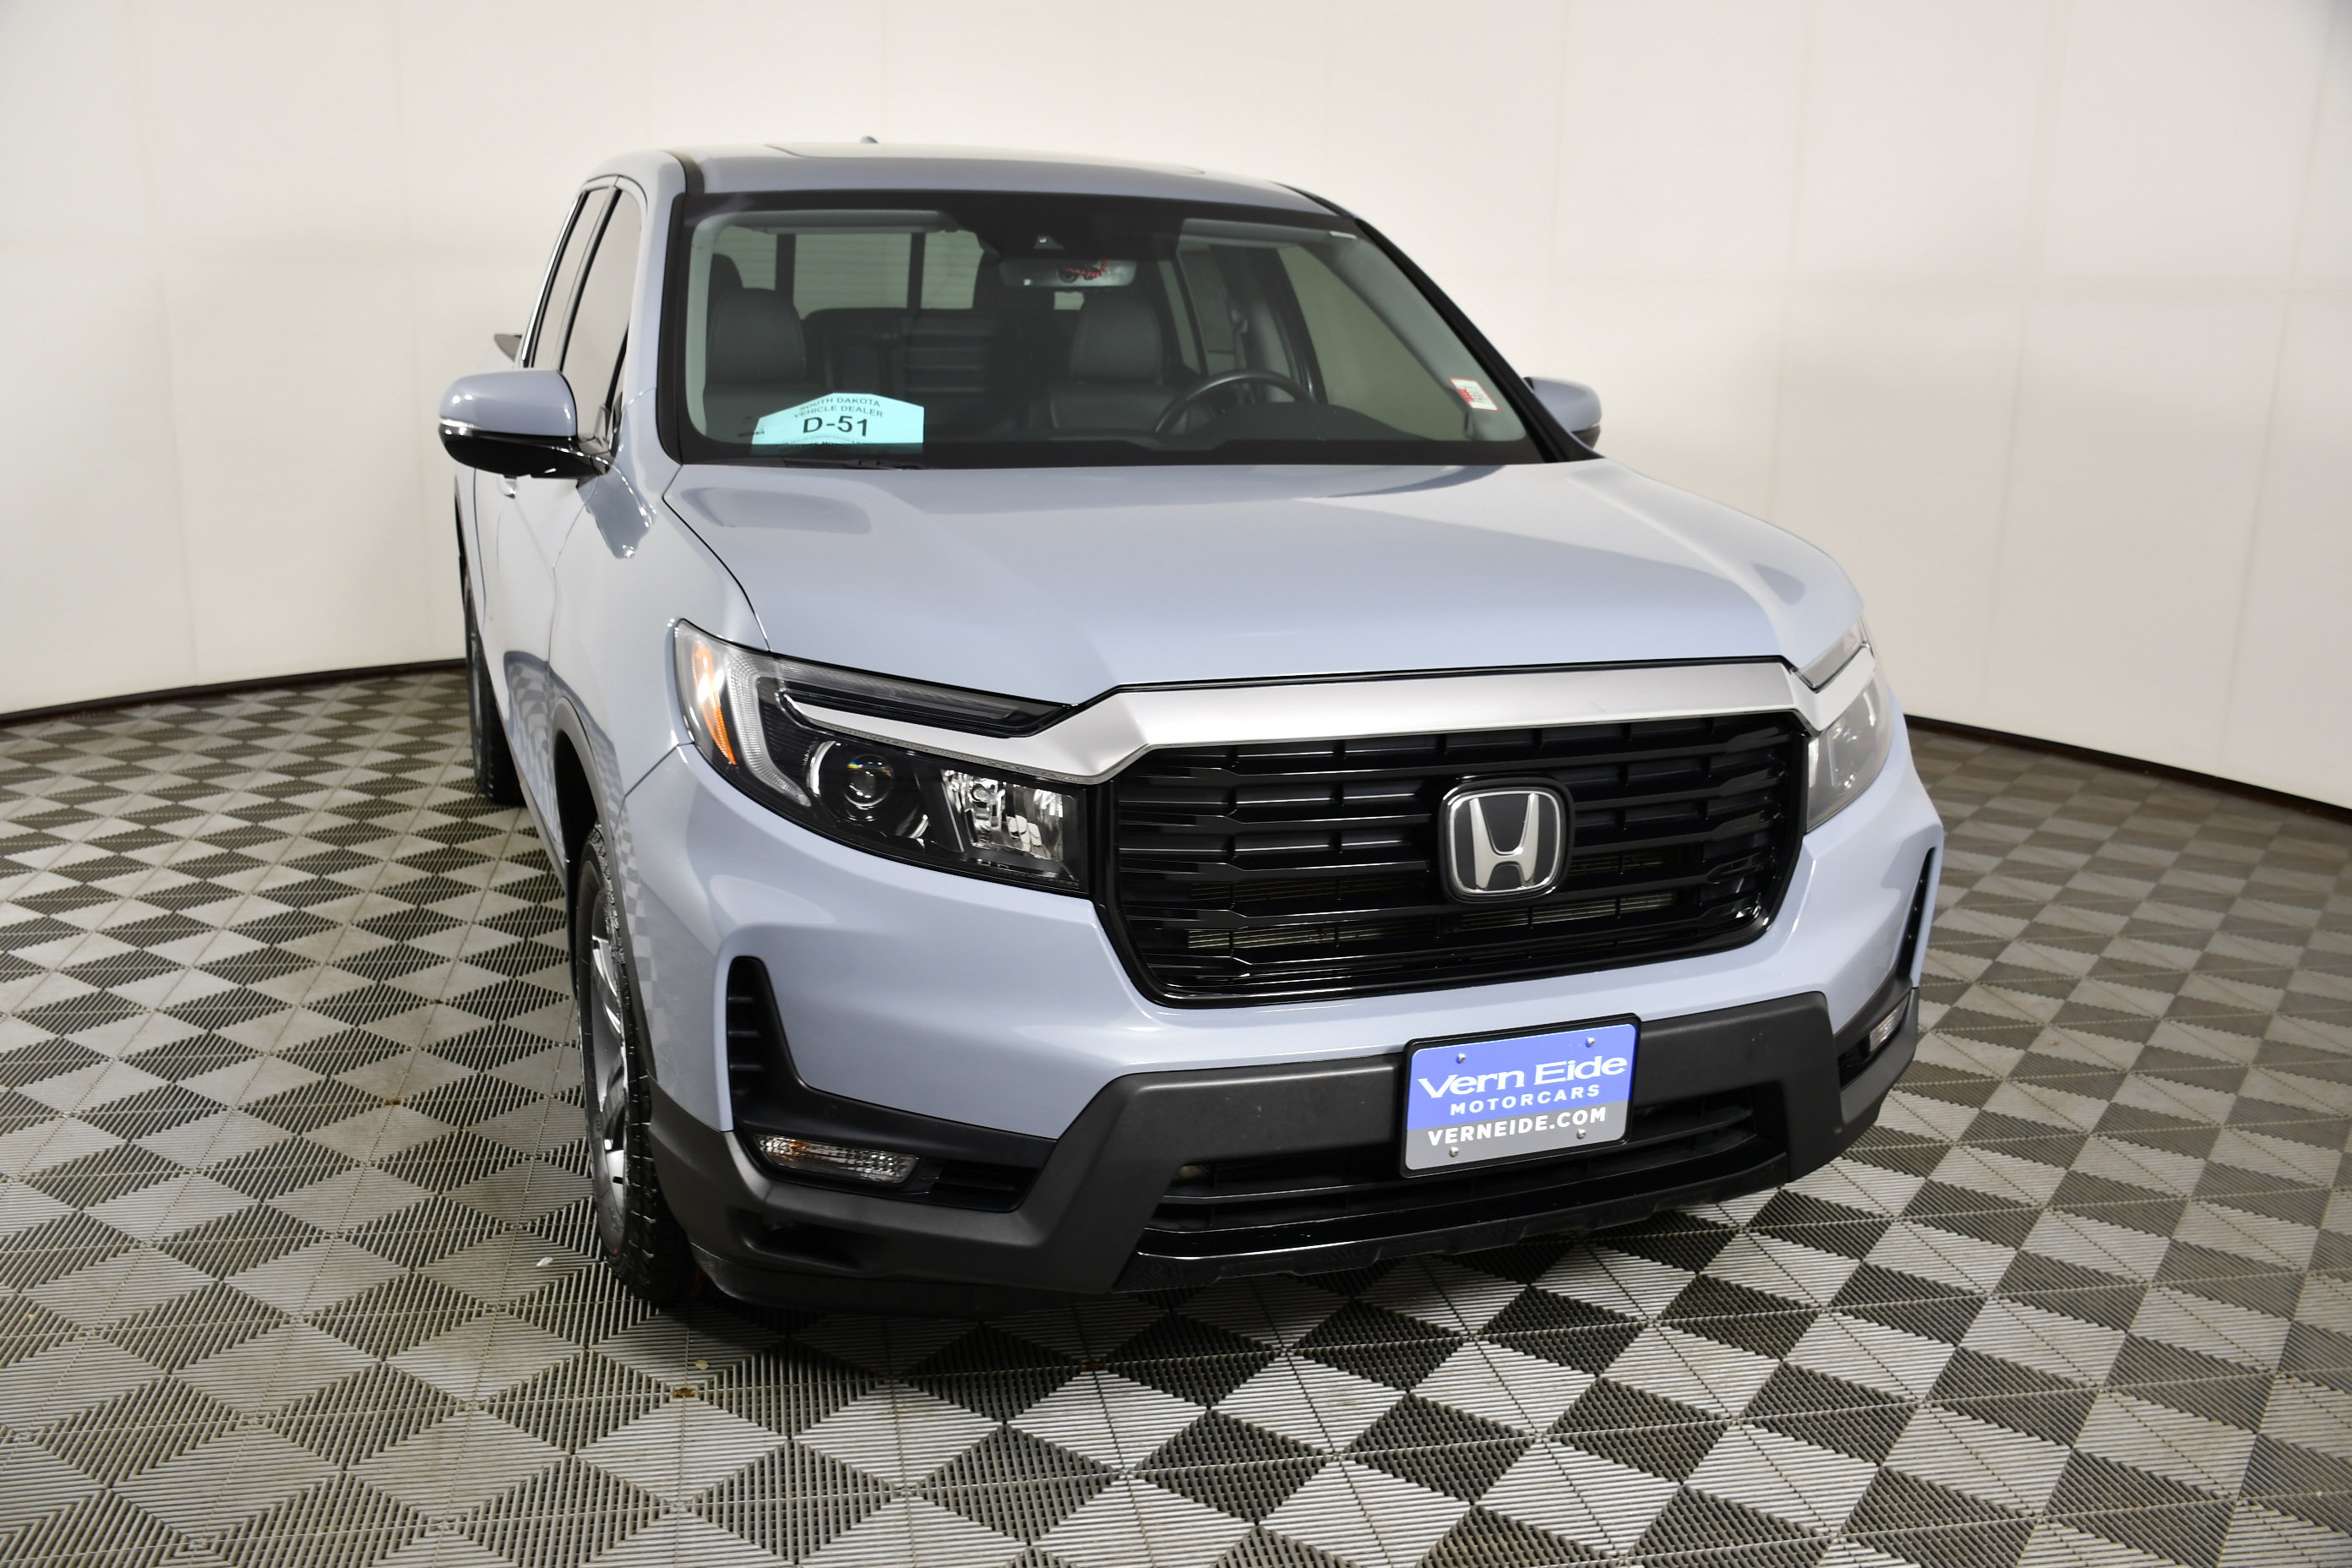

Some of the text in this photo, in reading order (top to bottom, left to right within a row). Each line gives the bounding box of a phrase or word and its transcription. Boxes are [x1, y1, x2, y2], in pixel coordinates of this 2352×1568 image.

[794, 406, 883, 418] VEHICLE DEALER
[836, 398, 880, 407] DAKOTA
[803, 415, 868, 437] D-51
[1417, 1055, 1627, 1098] Vern Eide
[1450, 1085, 1600, 1115] MOTORCARS
[1428, 1107, 1606, 1146] VERNEIDE.COM
